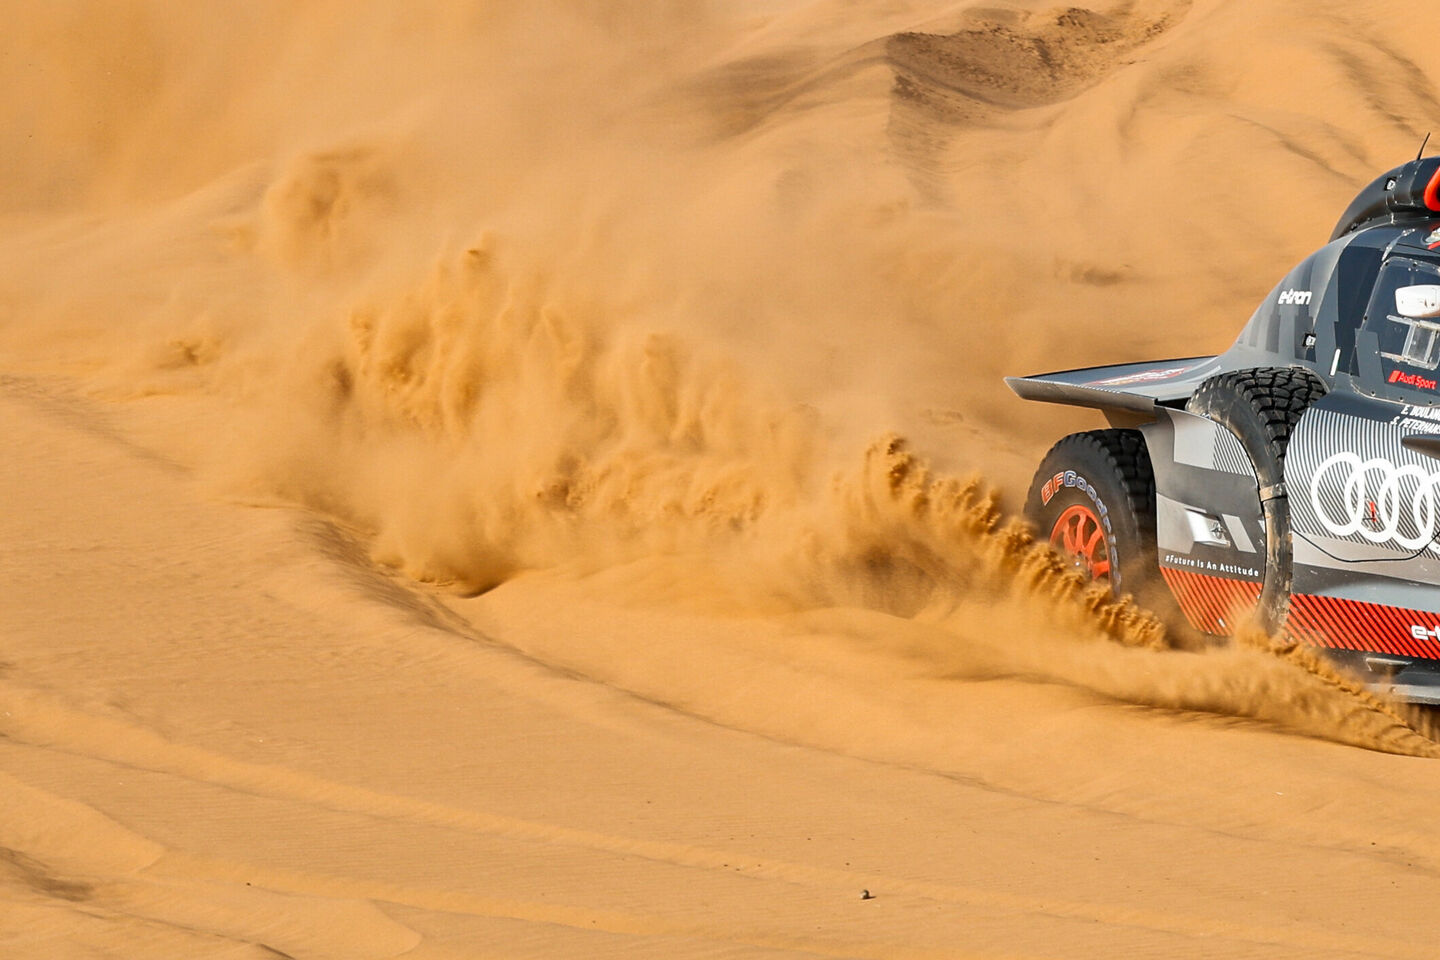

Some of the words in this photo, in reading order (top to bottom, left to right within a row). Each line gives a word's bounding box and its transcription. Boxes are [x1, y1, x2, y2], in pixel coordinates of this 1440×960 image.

[1278, 288, 1312, 305] e-tron
[1398, 372, 1417, 385] Audi
[1416, 376, 1438, 390] Sport
[1165, 554, 1195, 567] #Future
[1206, 560, 1218, 571] An
[1219, 563, 1259, 577] Attitude
